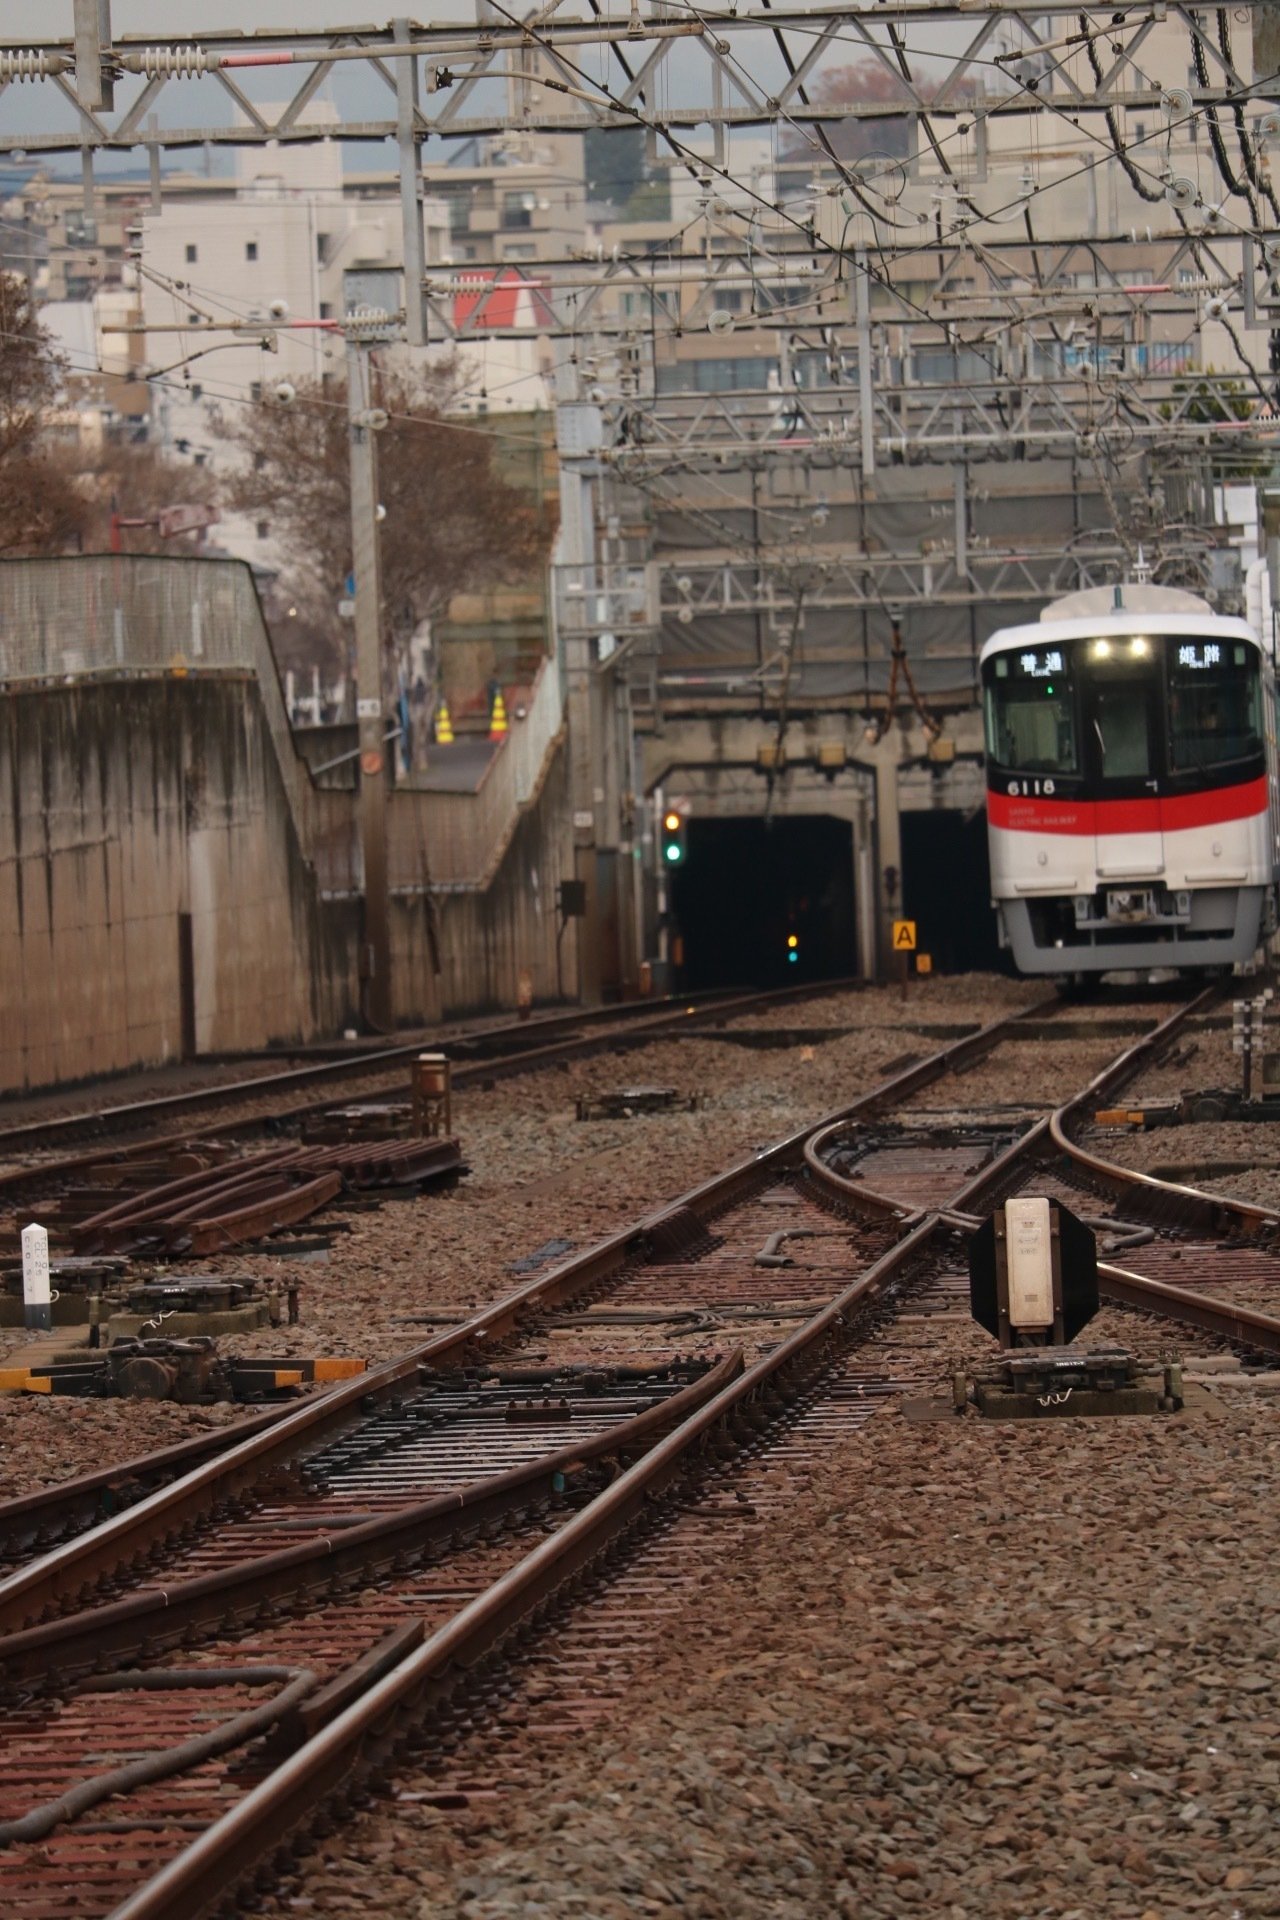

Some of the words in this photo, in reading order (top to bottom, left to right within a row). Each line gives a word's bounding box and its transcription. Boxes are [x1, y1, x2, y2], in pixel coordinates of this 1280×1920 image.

[1021, 653, 1062, 672] 普通
[1007, 780, 1055, 796] 6118
[897, 925, 913, 945] A
